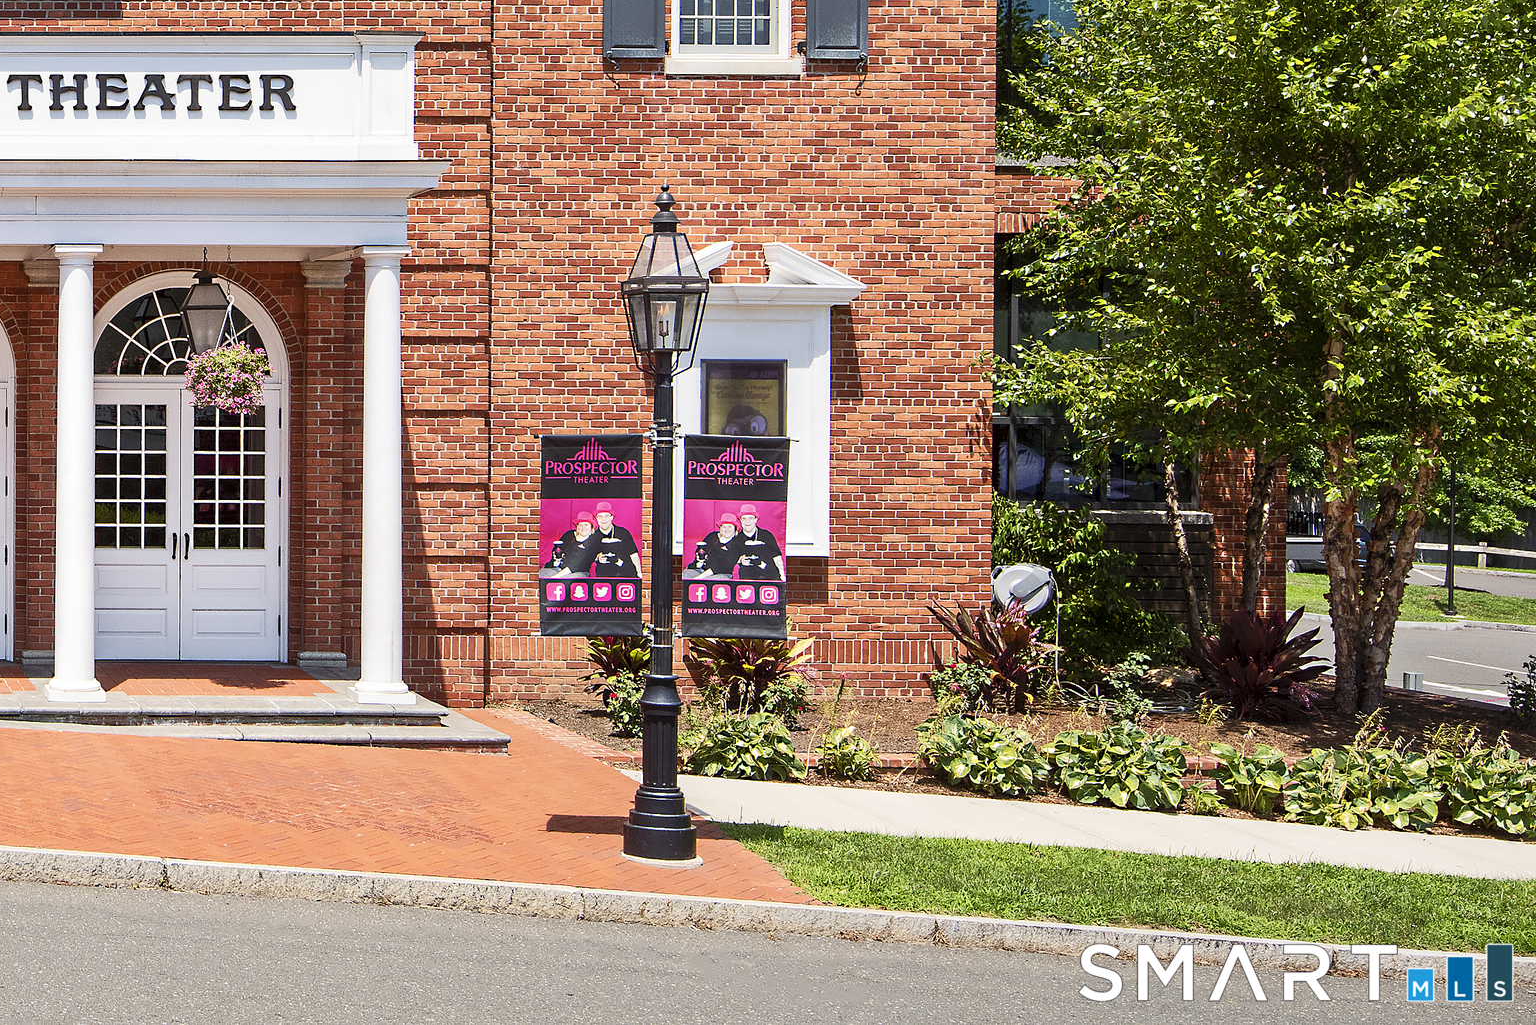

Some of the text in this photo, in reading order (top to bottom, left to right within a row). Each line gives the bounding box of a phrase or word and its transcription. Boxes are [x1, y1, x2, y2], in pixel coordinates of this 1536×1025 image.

[6, 73, 297, 112] THEATER
[545, 460, 638, 475] PROSPECTOR
[688, 460, 784, 477] PROSPECTOR
[573, 476, 609, 484] THEATER
[717, 477, 754, 486] THEATER
[687, 608, 780, 616] WWW.PROSPECTORTHEATER.ORG
